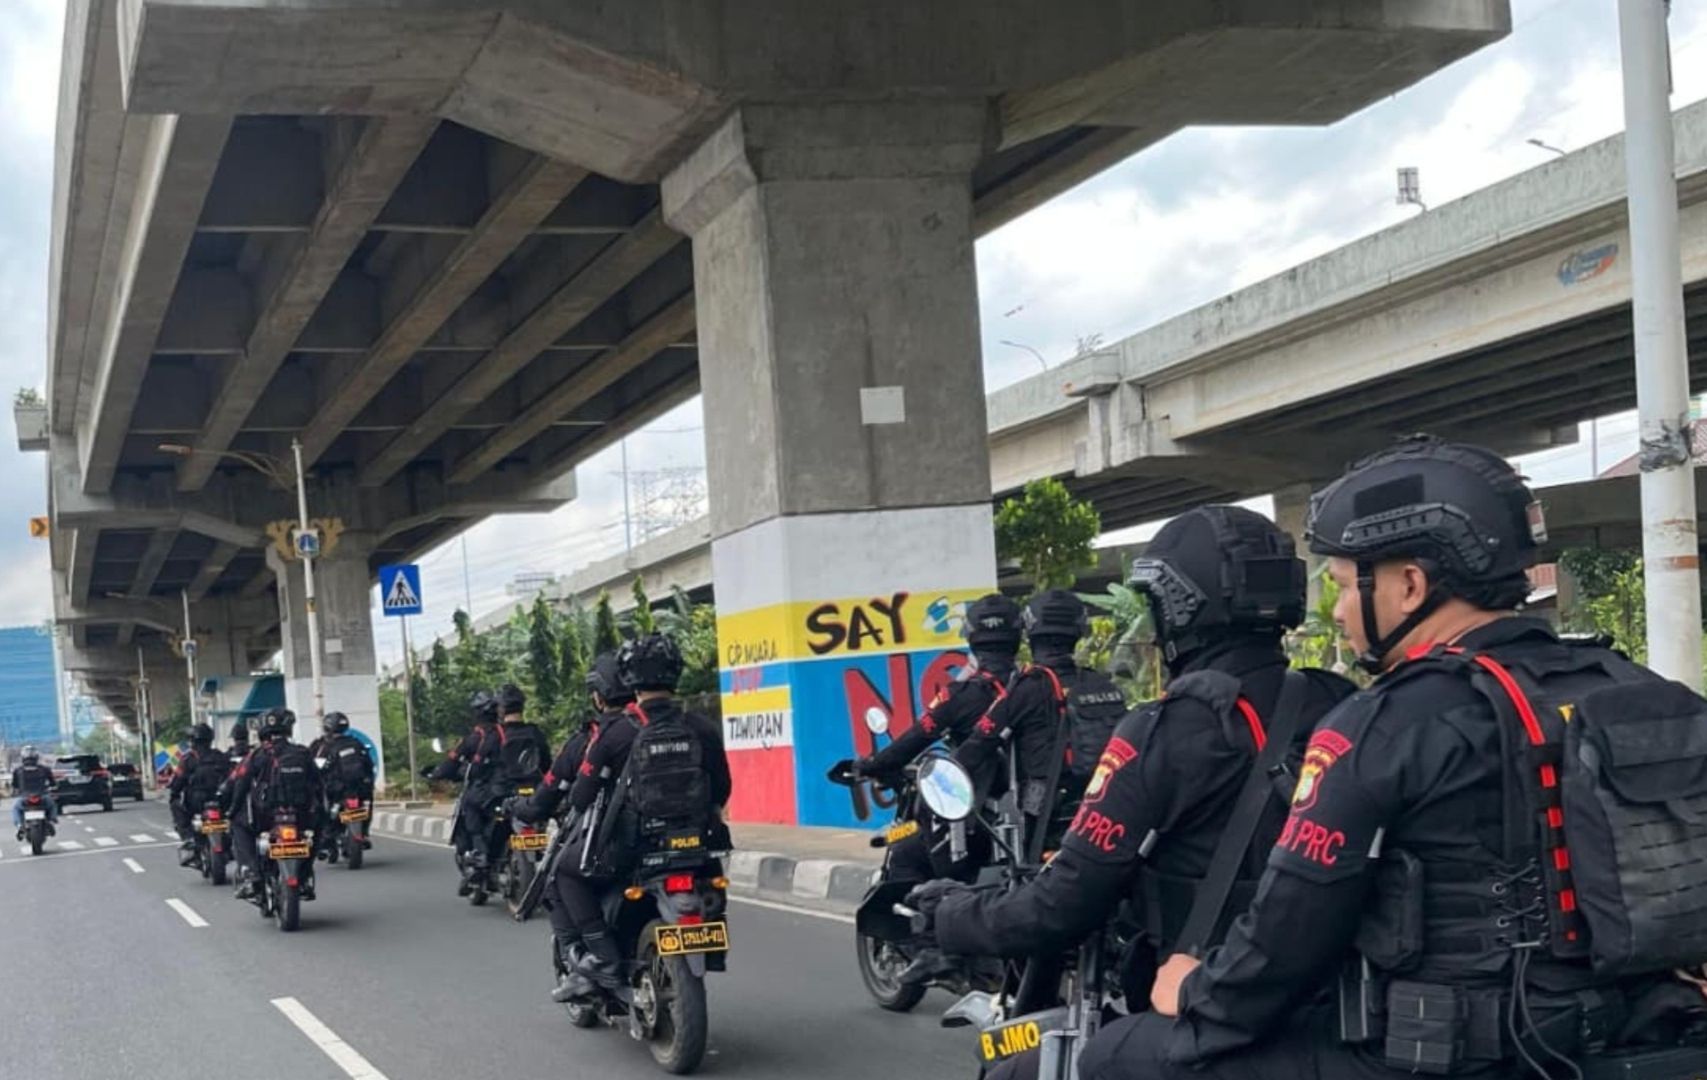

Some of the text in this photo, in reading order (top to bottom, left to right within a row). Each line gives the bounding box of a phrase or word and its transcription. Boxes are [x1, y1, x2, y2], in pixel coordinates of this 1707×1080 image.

[806, 592, 908, 654] SAY
[727, 713, 784, 740] TAWURAN
[671, 835, 700, 849] POLISI
[1078, 811, 1126, 852] PRC
[1289, 819, 1346, 866] PRC
